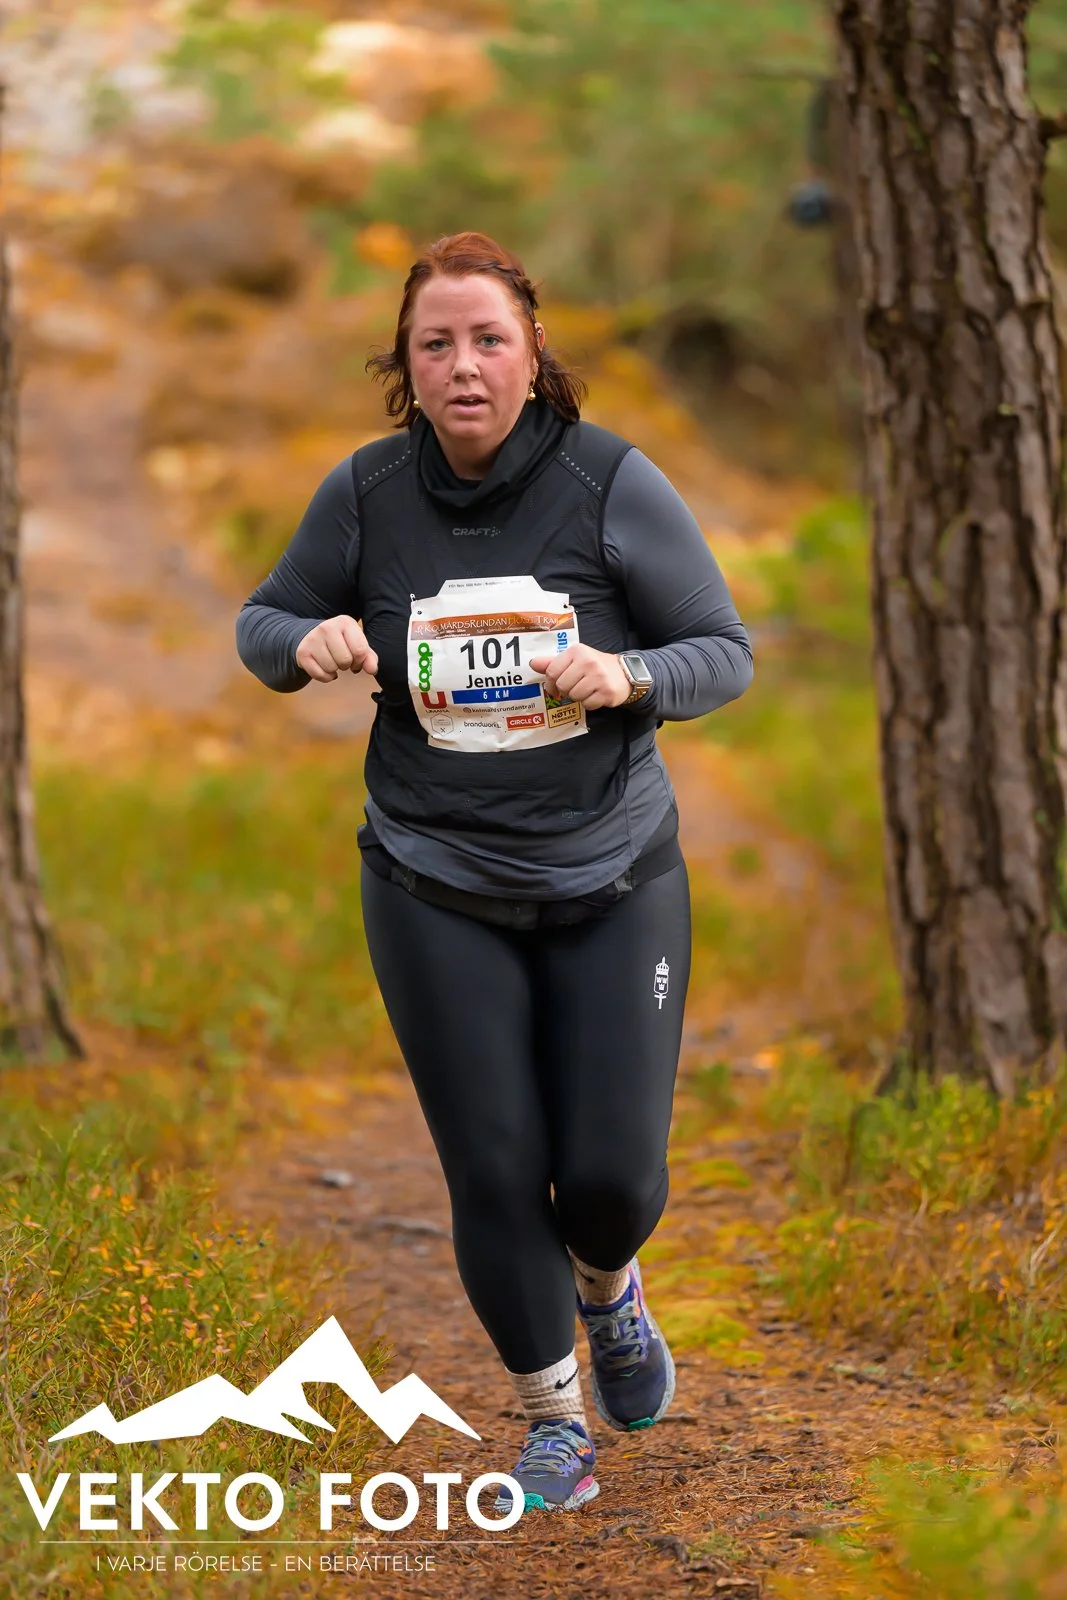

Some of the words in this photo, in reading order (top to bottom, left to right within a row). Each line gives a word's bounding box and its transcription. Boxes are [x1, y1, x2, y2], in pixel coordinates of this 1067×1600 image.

[452, 528, 490, 536] CRAFT
[460, 635, 521, 670] 101
[417, 642, 433, 692] coop
[466, 672, 523, 689] Jennie
[483, 691, 488, 700] 6
[509, 718, 532, 726] CIRCLE
[534, 716, 541, 724] K
